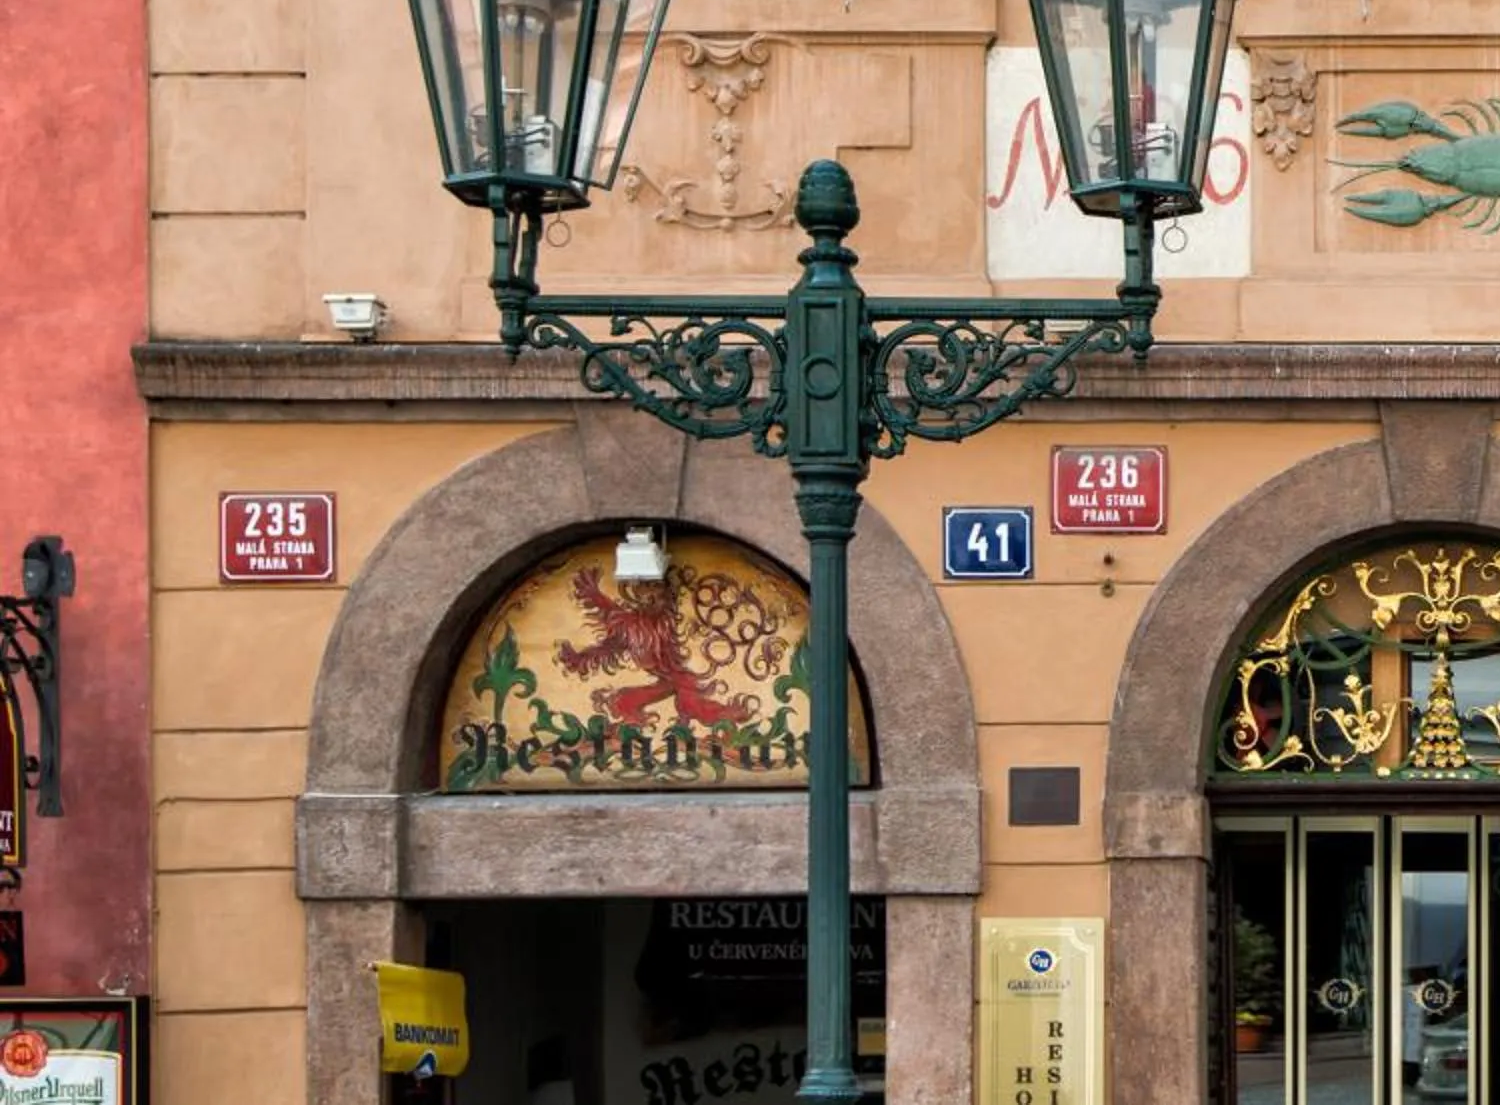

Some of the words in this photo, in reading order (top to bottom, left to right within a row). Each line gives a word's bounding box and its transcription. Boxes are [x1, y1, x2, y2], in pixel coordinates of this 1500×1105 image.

[1077, 454, 1138, 489] 236
[1068, 491, 1098, 507] MALÁ
[1105, 493, 1146, 507] STRANA
[244, 502, 306, 536] 235
[1083, 509, 1120, 522] PRAHA
[1128, 510, 1135, 523] 1
[235, 538, 266, 555] MALÁ
[273, 540, 315, 555] STRANA
[967, 523, 1009, 562] 41
[249, 556, 288, 570] PRAHA
[296, 557, 303, 570] 1
[669, 901, 884, 930] RESTAUN
[688, 943, 703, 959] U
[708, 937, 808, 960] ČERVENÉ
[394, 1022, 460, 1047] BANKOMAT
[45, 1074, 104, 1103] Urquell
